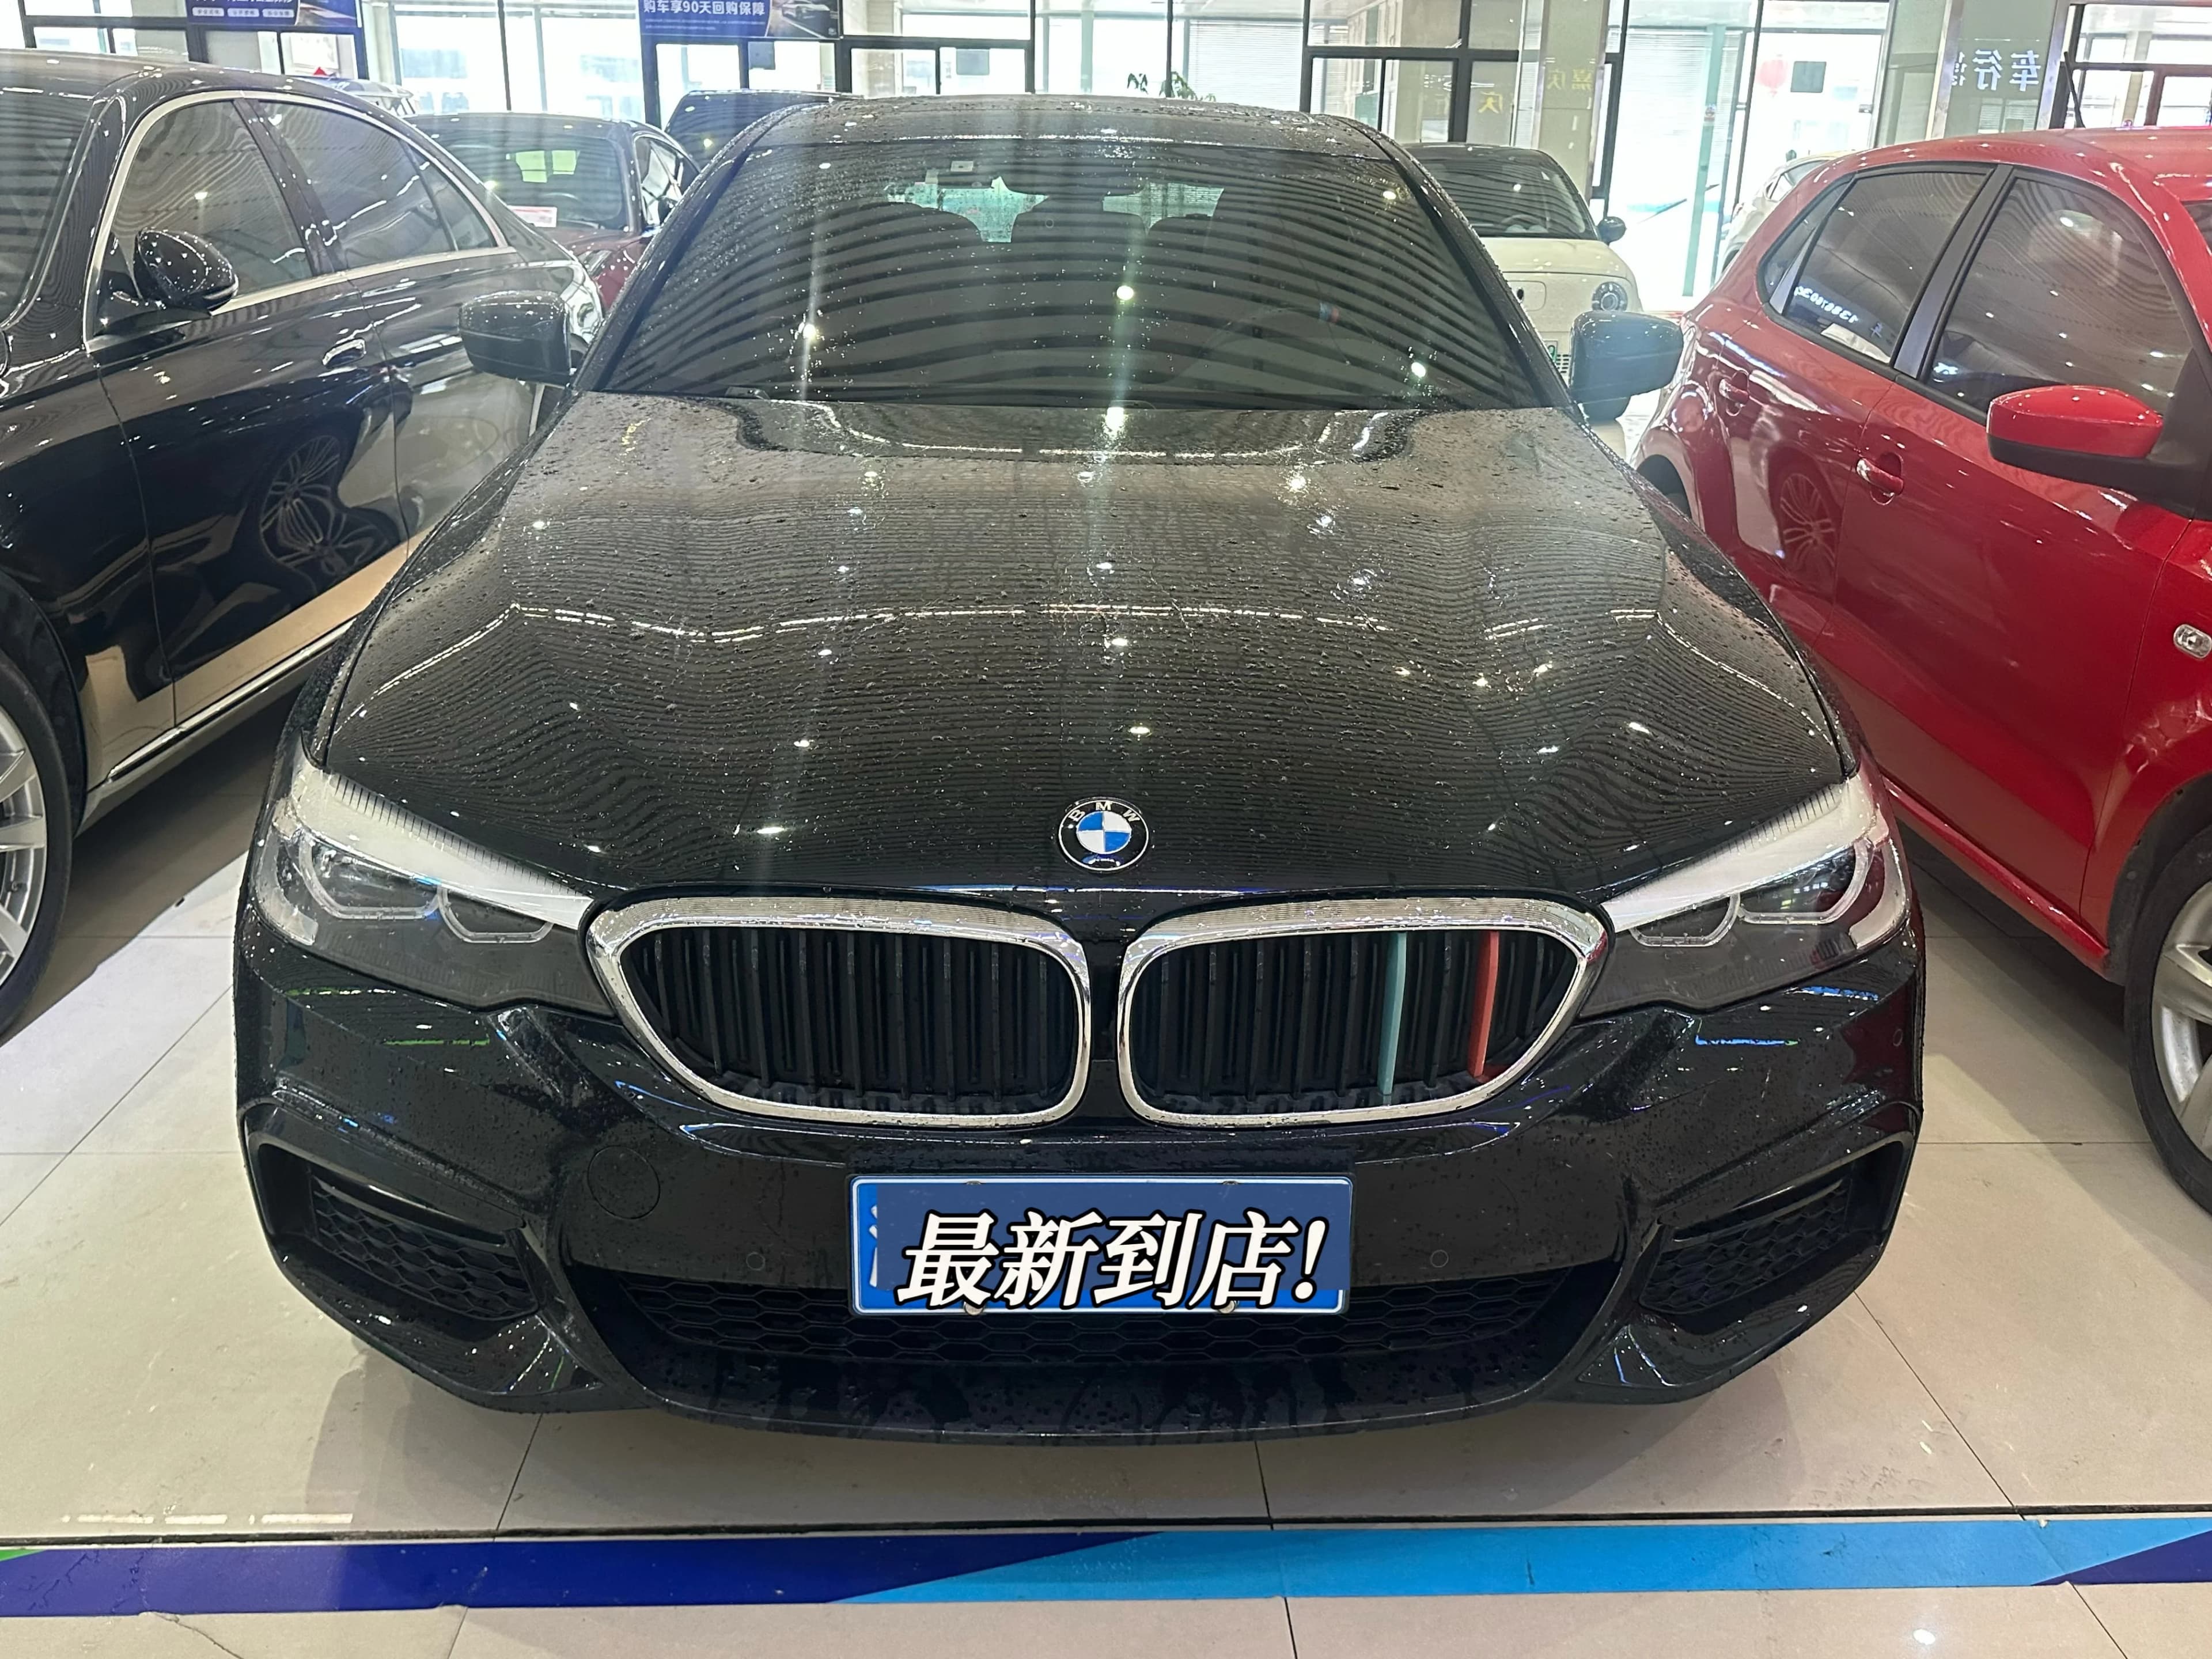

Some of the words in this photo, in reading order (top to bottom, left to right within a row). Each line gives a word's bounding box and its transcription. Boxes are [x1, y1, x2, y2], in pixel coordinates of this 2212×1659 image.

[643, 0, 765, 15] 购车享90天回购保障
[1068, 801, 1141, 823] BMW
